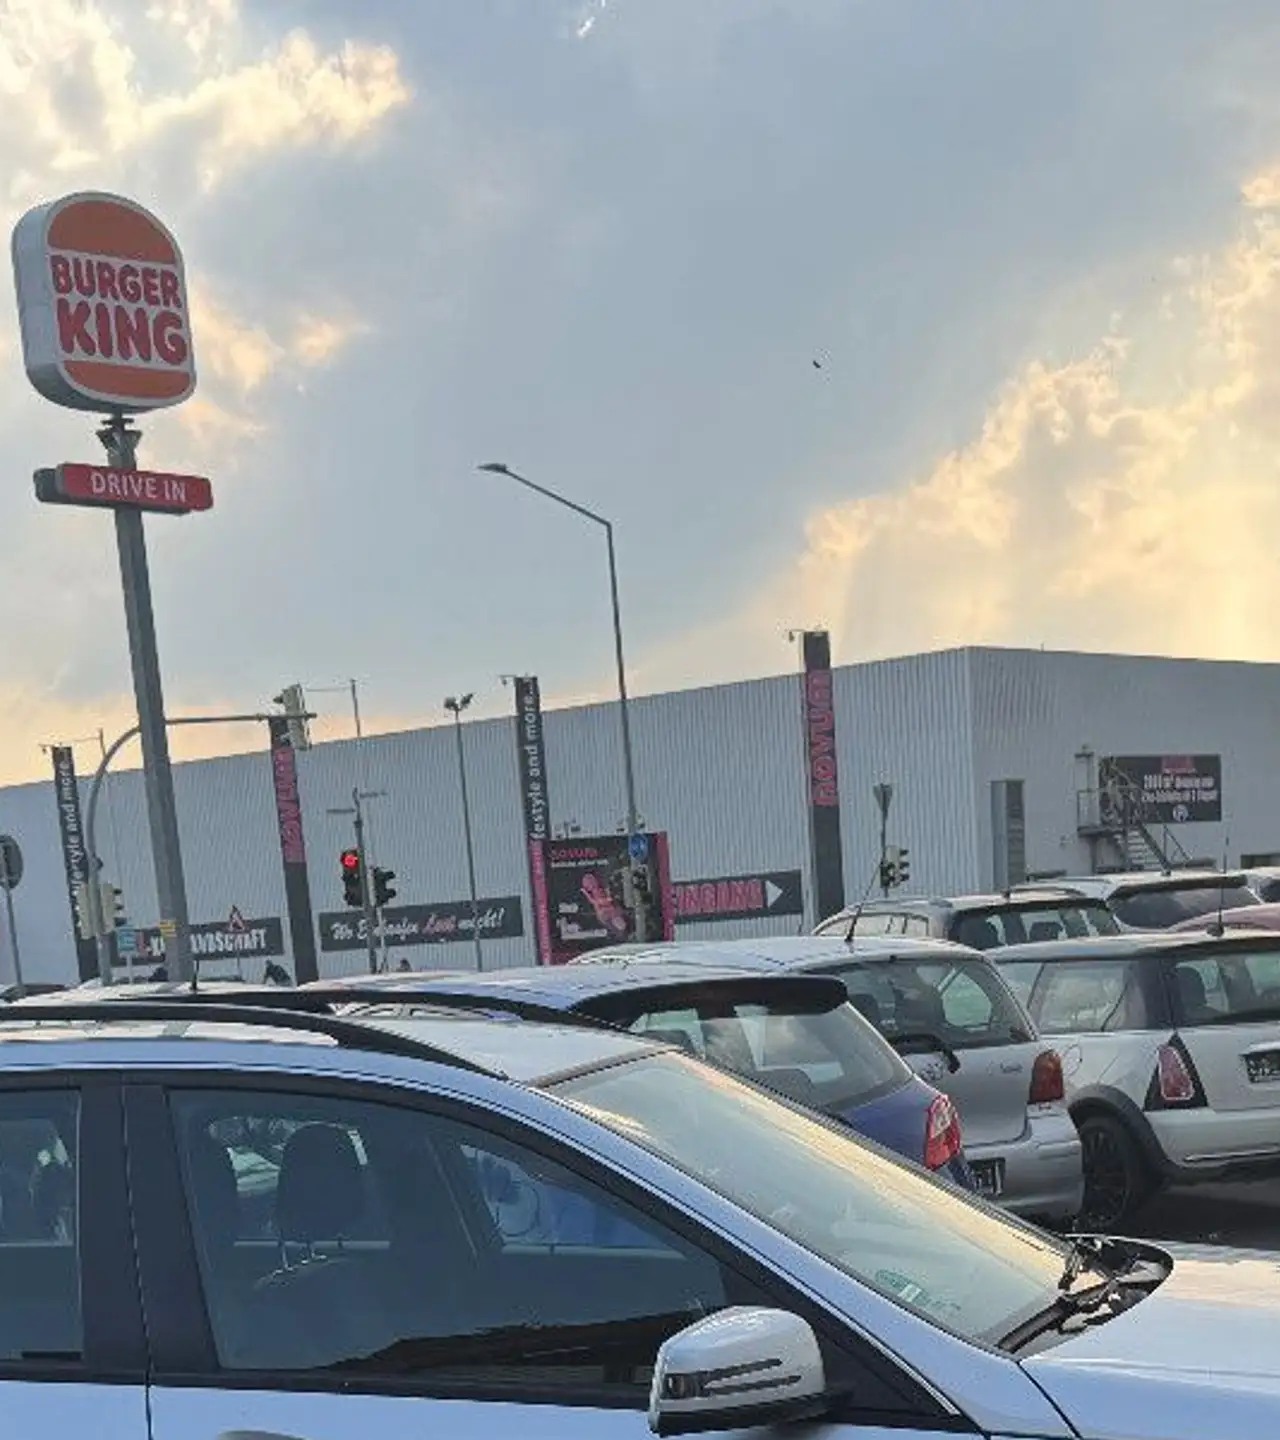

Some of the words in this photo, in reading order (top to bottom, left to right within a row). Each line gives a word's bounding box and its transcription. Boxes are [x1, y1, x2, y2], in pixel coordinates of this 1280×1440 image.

[49, 254, 183, 308] BURGER
[56, 297, 188, 366] KING
[90, 472, 157, 499] DRIVE
[164, 479, 187, 502] IN
